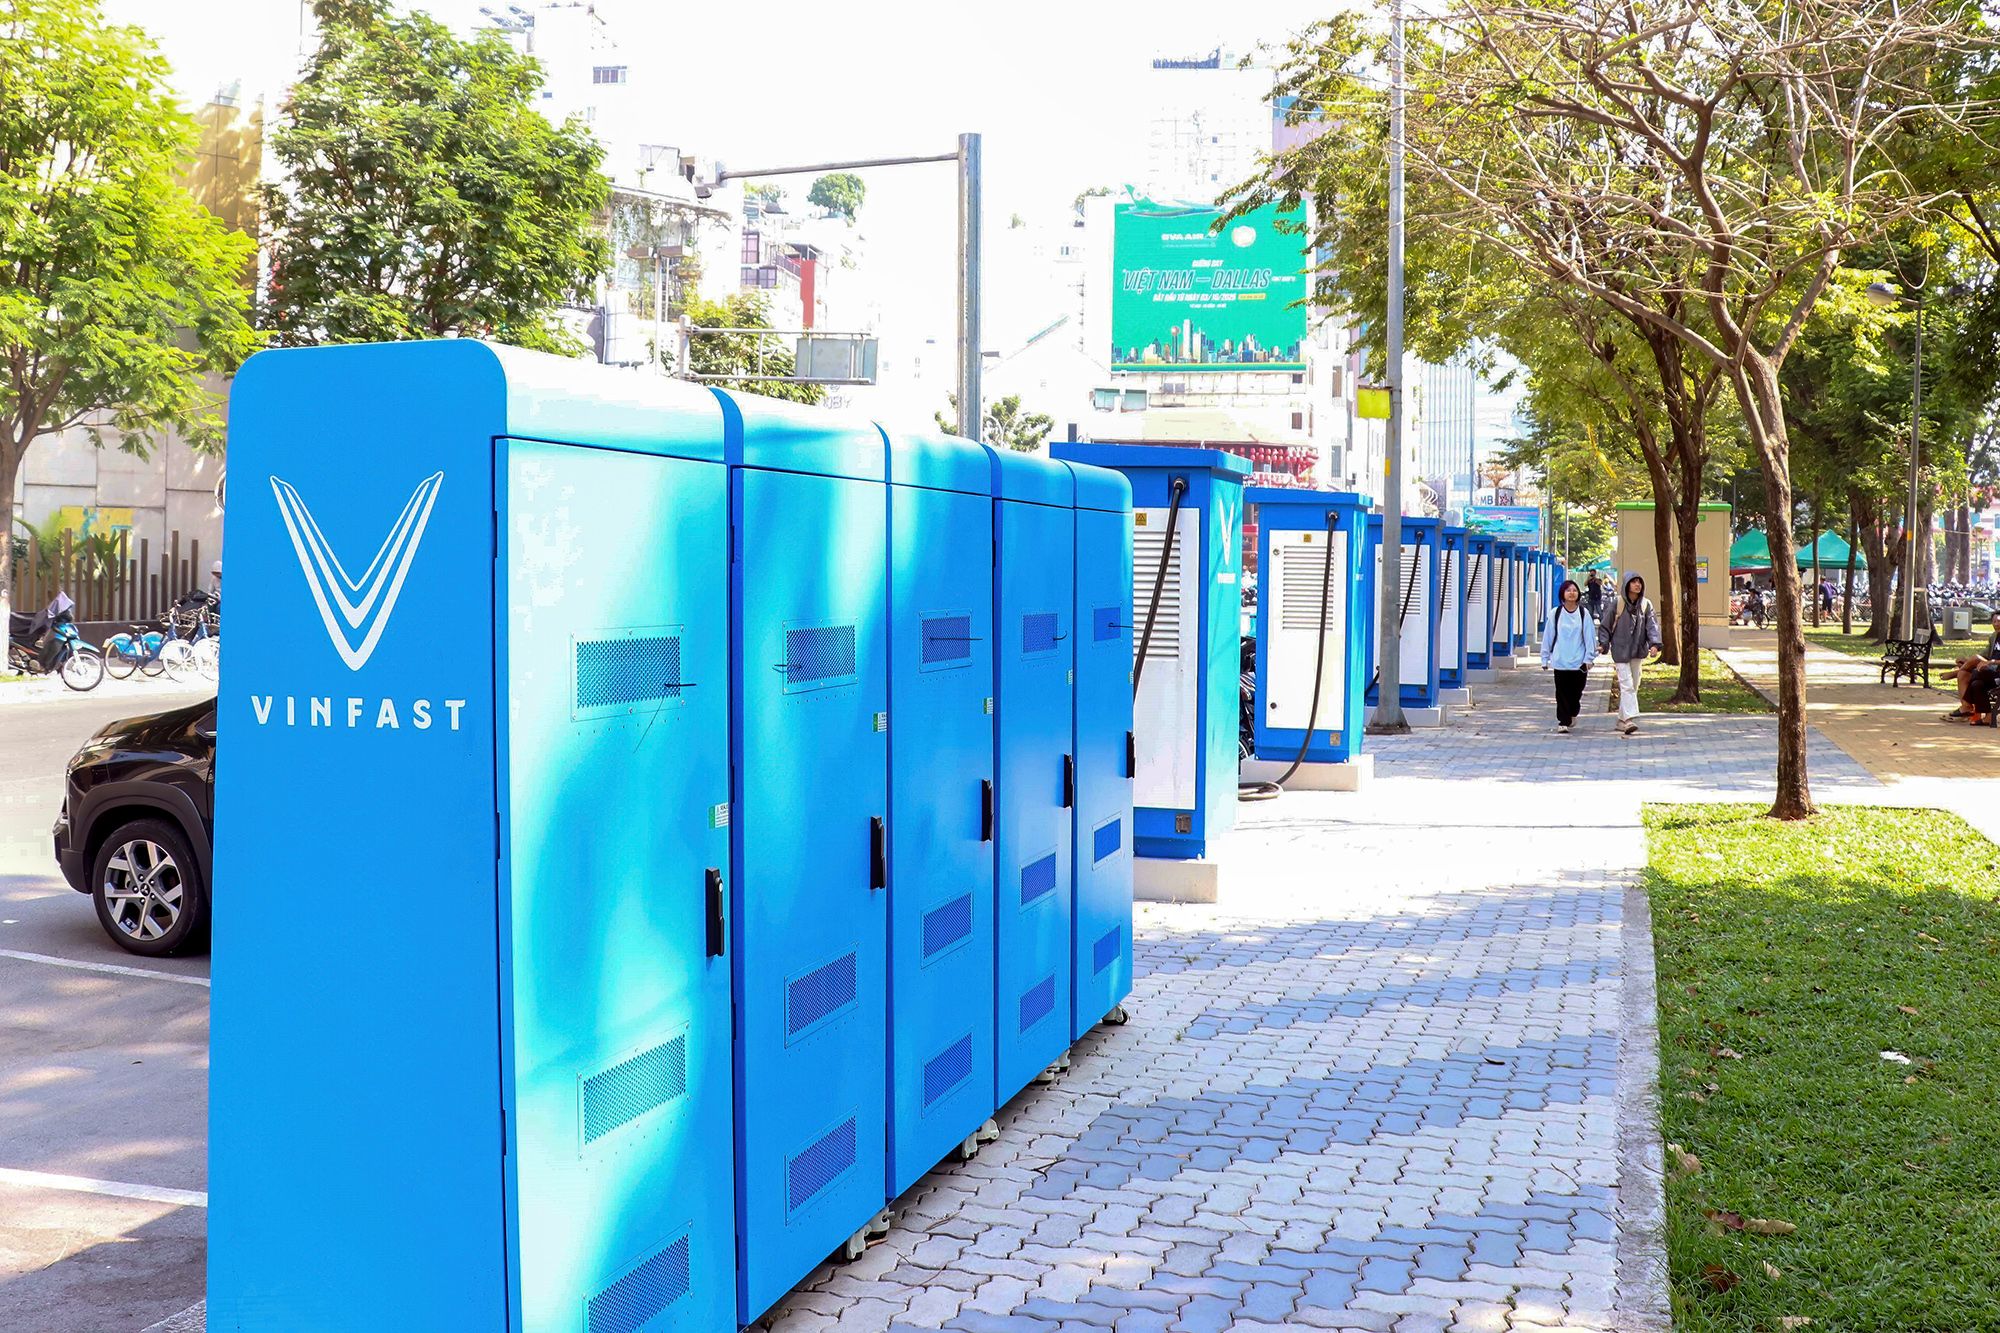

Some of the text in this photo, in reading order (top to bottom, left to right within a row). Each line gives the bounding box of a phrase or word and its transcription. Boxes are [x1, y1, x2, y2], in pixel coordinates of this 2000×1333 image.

[1123, 267, 1159, 294] VIỆT
[1157, 269, 1196, 290] NAM
[1211, 268, 1272, 290] DALLAS
[251, 696, 466, 731] VINFAST
